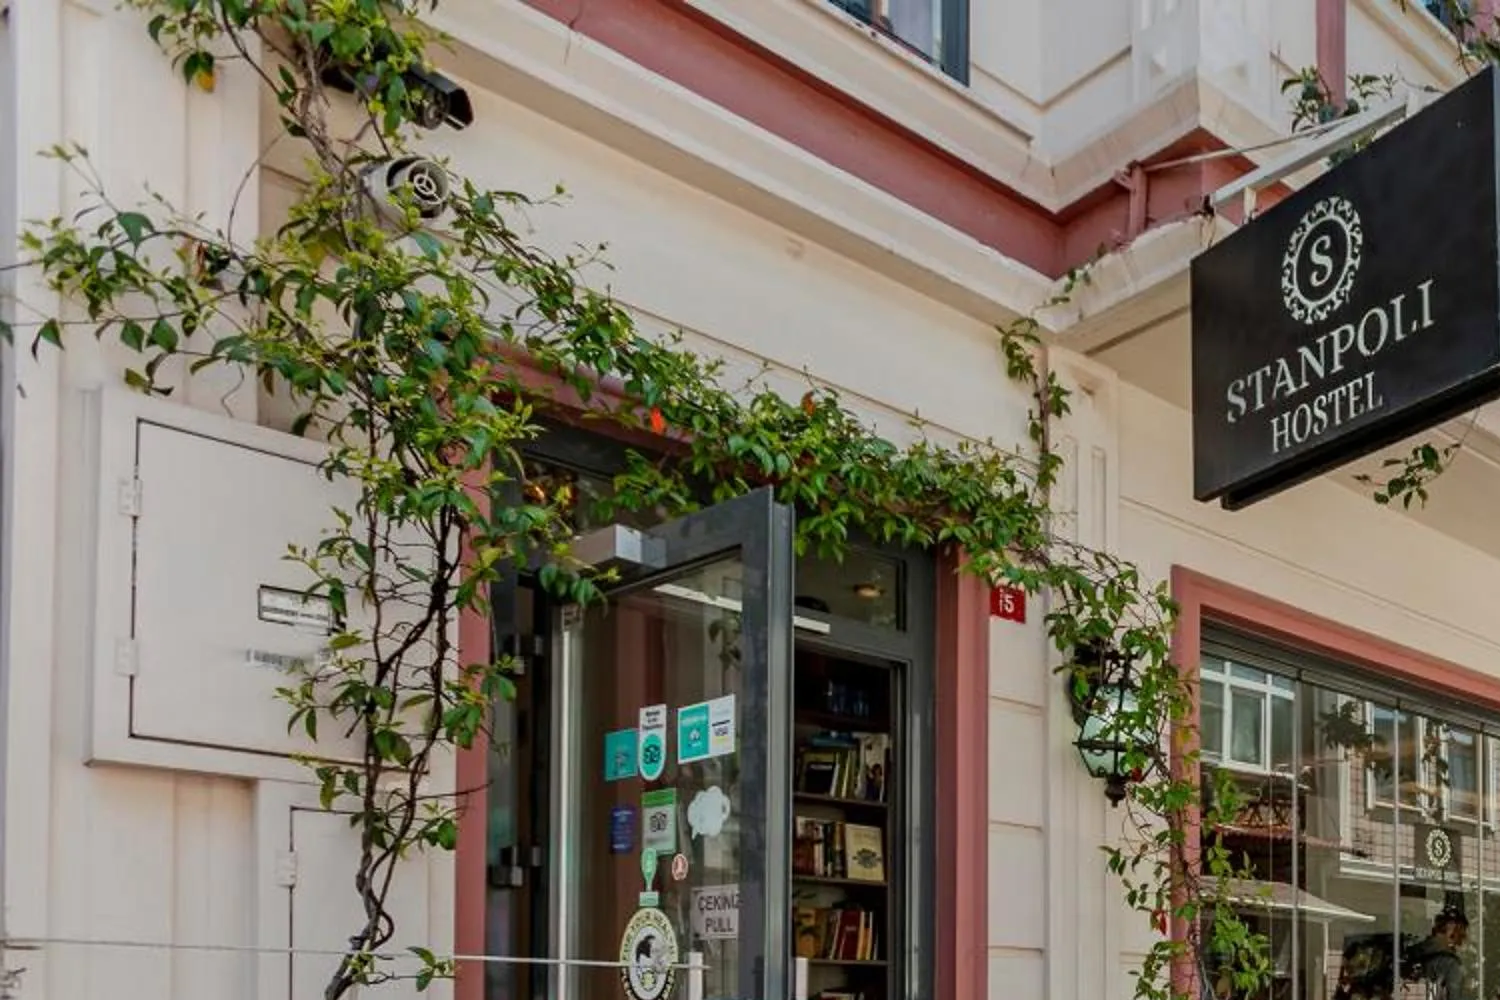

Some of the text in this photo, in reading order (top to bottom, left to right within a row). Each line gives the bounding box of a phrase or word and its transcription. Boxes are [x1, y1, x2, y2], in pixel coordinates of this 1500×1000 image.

[1310, 235, 1333, 287] S
[1227, 279, 1434, 423] STANPOLI
[1270, 371, 1383, 454] HOSTEL
[704, 917, 734, 933] PULL
